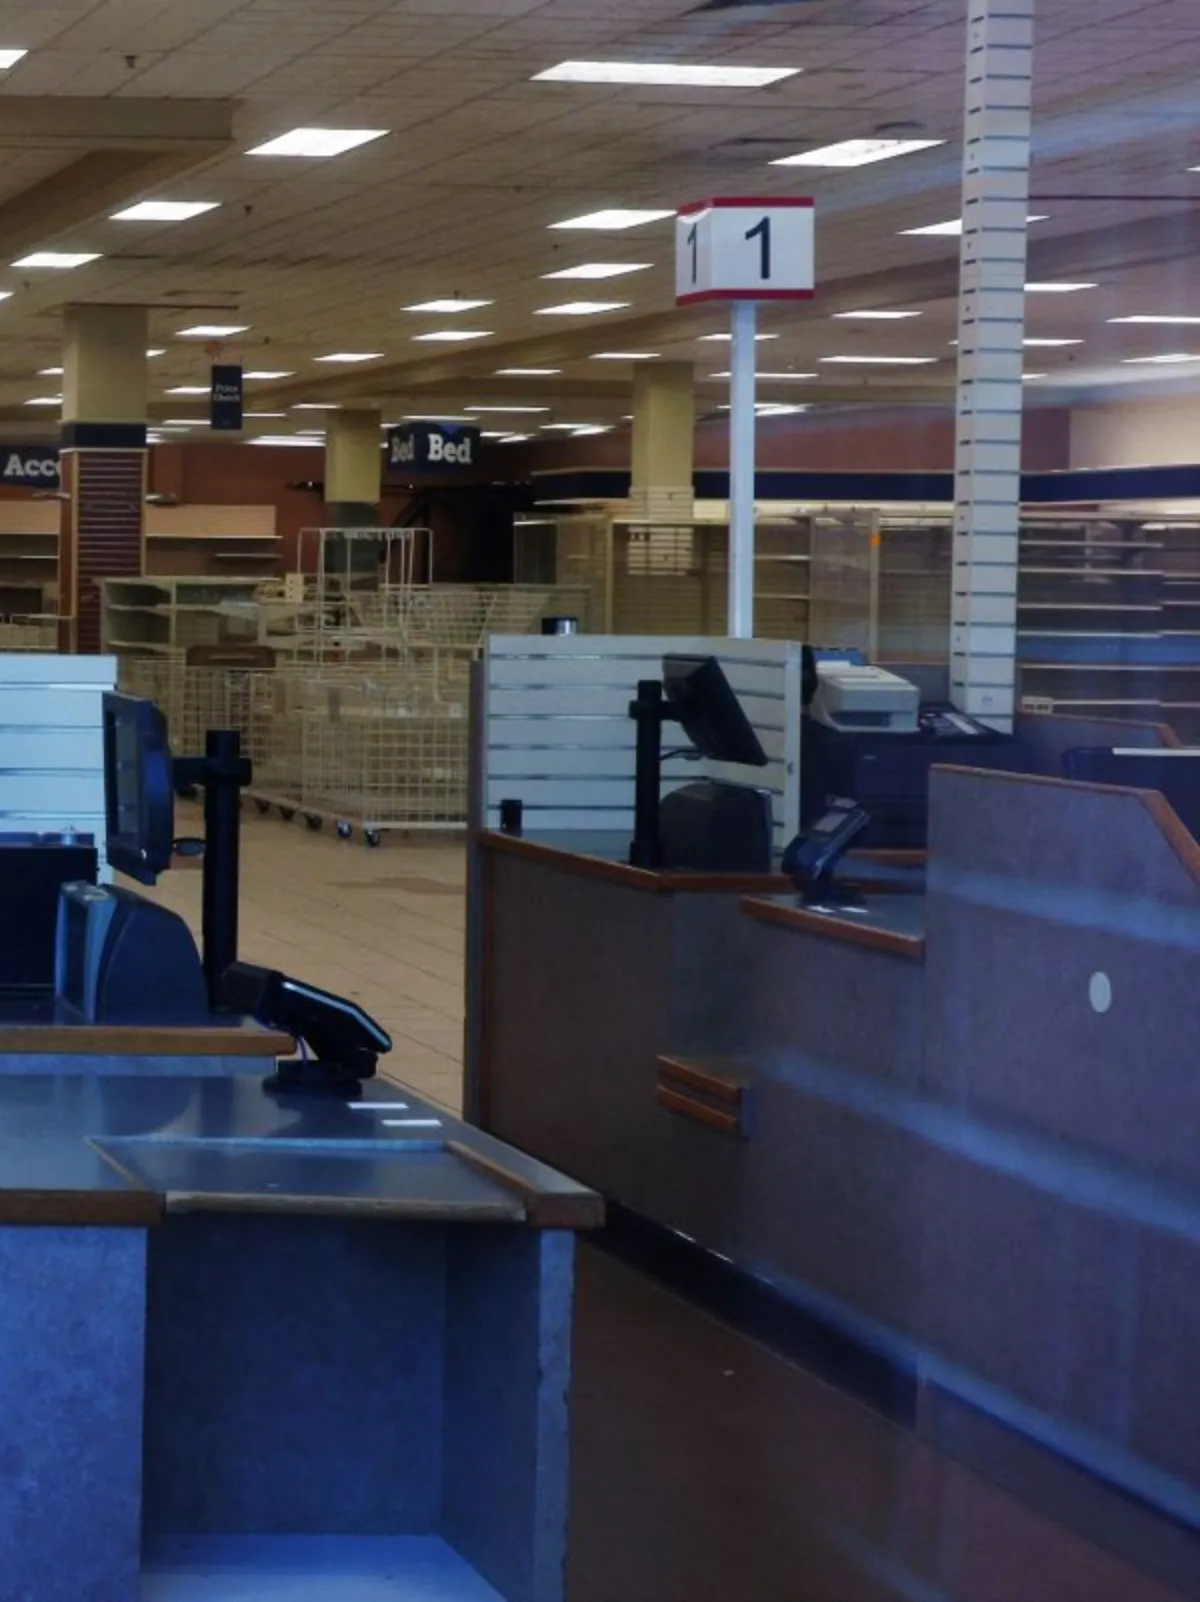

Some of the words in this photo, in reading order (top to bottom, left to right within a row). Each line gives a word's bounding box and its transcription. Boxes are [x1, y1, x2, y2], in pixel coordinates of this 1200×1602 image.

[687, 222, 697, 284] 1
[745, 216, 770, 280] 1
[428, 433, 472, 464] Bed
